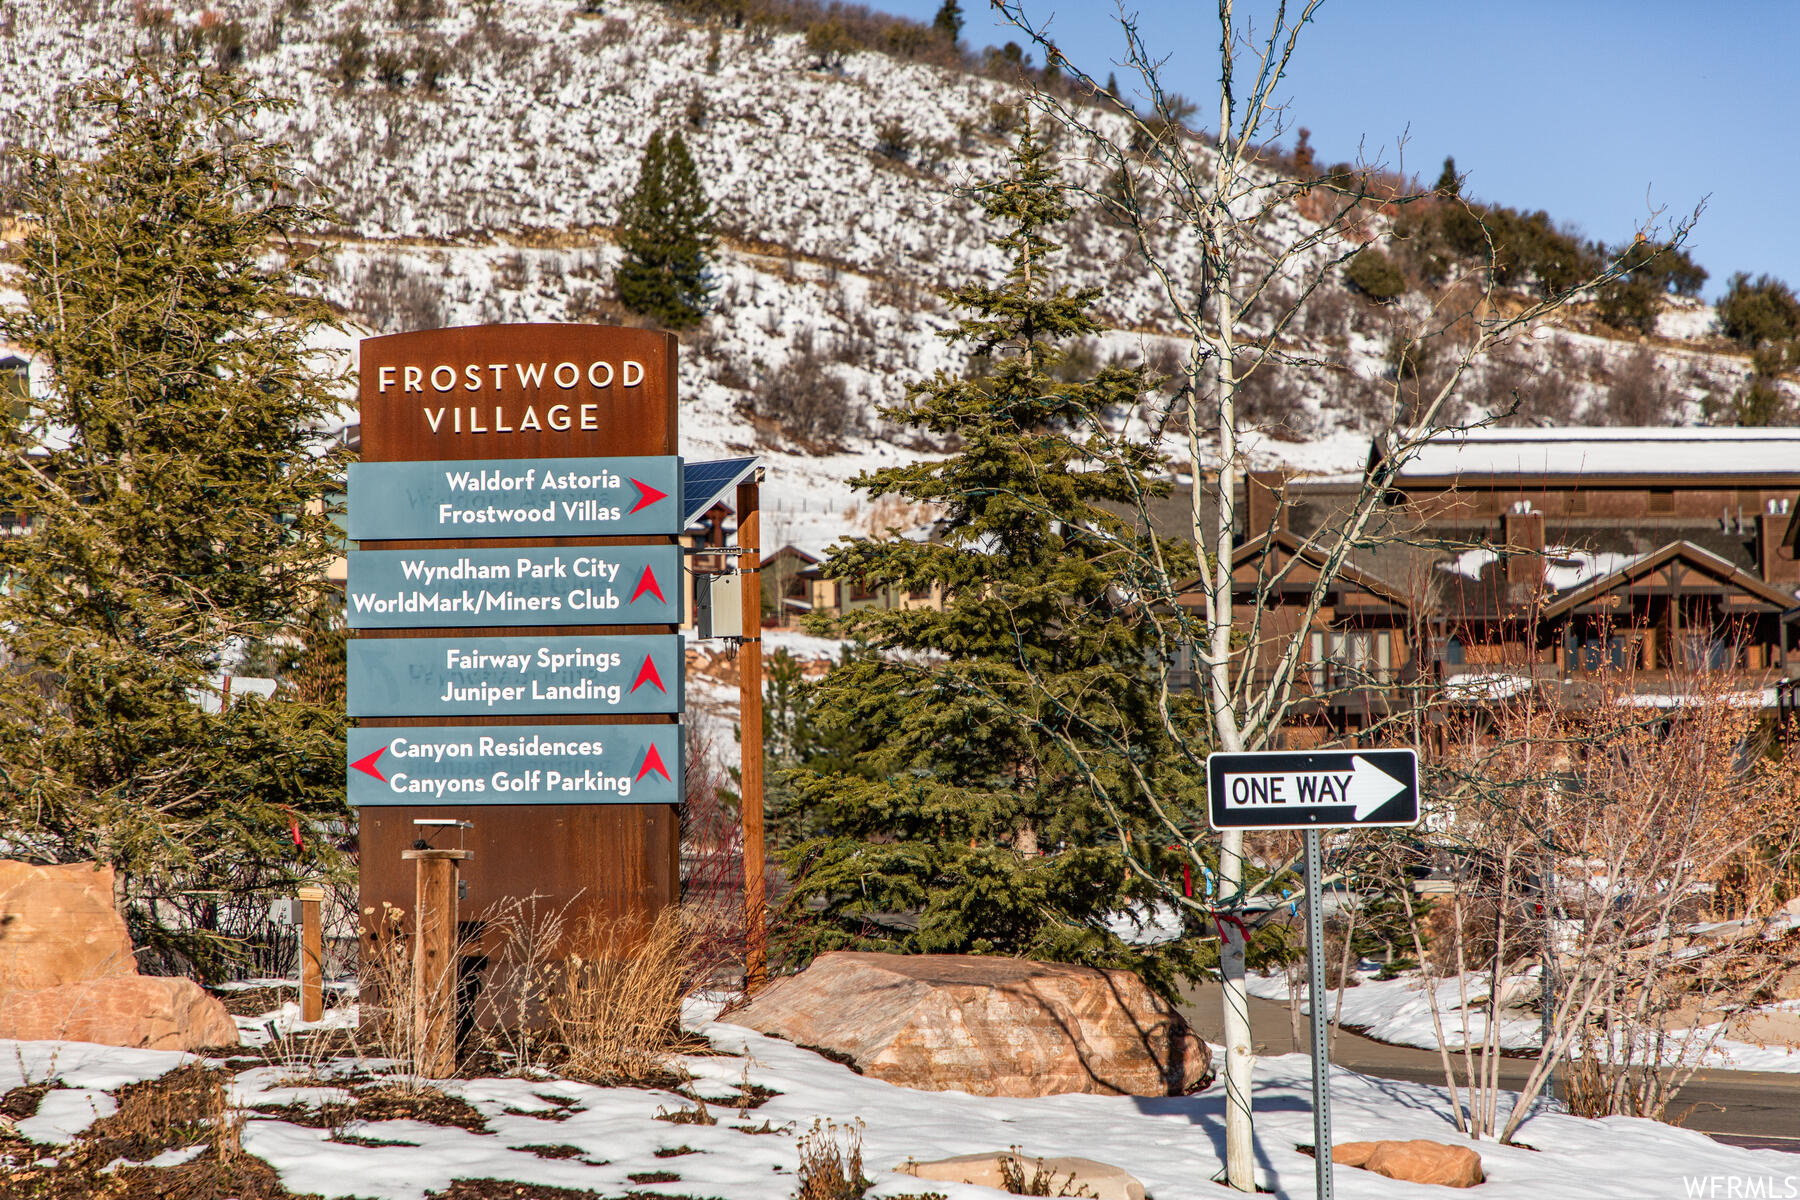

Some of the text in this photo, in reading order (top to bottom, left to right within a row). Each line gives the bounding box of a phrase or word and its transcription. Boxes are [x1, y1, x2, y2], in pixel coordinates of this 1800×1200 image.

[378, 361, 645, 393] FROSTWOOD
[424, 404, 599, 433] VILLAGE
[445, 469, 621, 492] Waldorf Astoria
[439, 500, 621, 524] Frostwood Villas
[401, 557, 620, 585] Wyndham Park City
[352, 589, 620, 614] WorldMark/Miners Club
[447, 648, 621, 673] Fairway Springs
[441, 679, 621, 706] Juniper Landing
[390, 735, 603, 762] Canyon Residences
[390, 771, 632, 798] Canyons Golf Parking
[1232, 775, 1353, 804] ONE WAY
